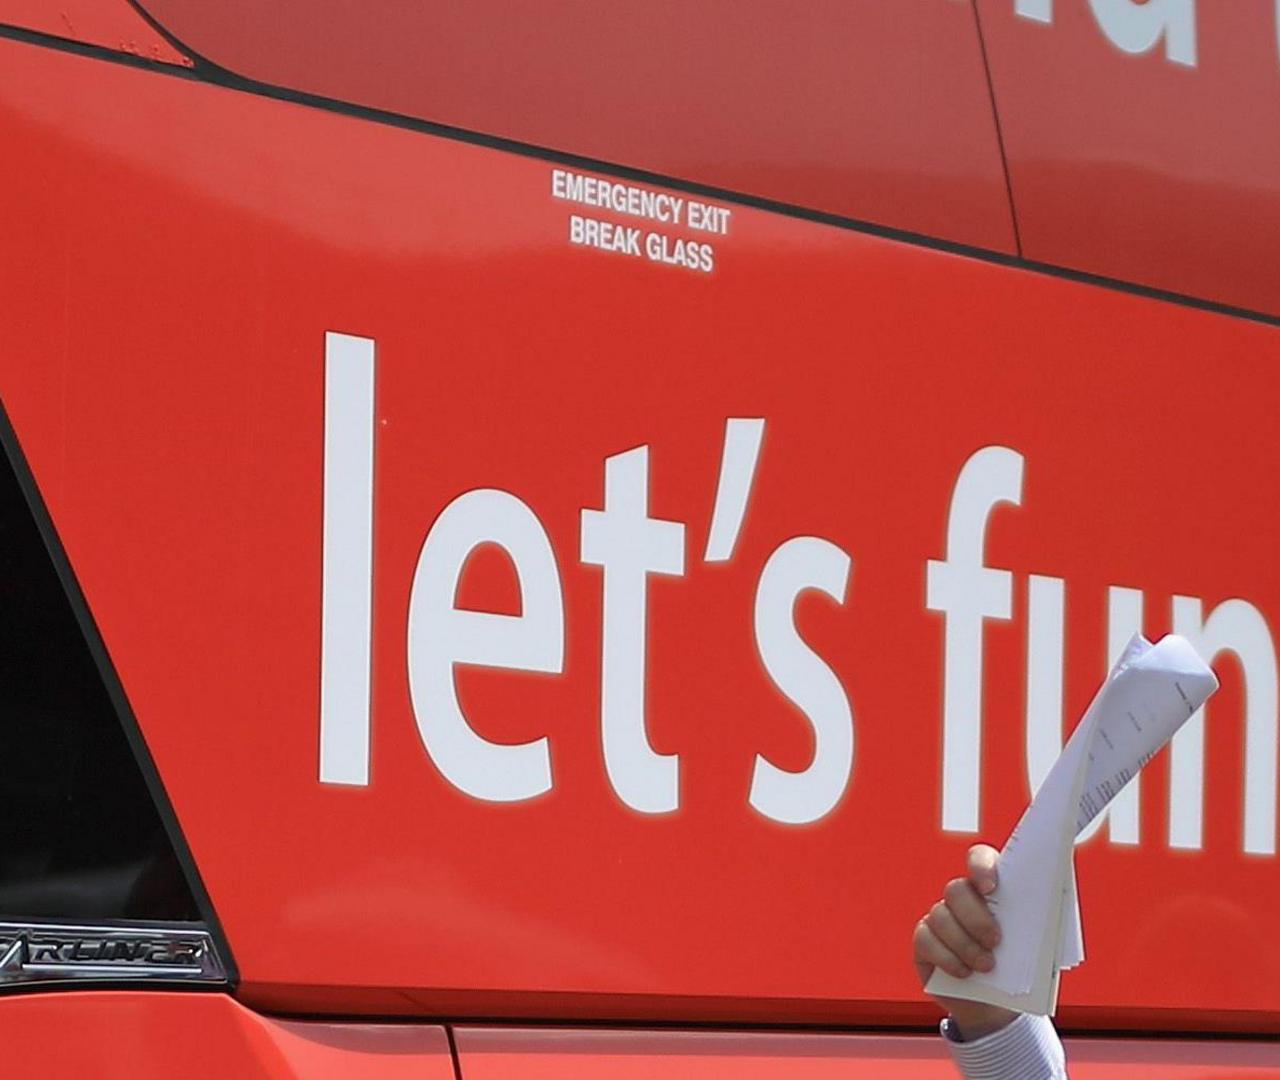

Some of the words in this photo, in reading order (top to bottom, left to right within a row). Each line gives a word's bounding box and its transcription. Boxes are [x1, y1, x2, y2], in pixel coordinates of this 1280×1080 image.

[552, 169, 683, 225] EMERGENCY
[687, 201, 731, 234] EXIT
[570, 215, 641, 257] BREAK
[646, 232, 714, 272] GLASS
